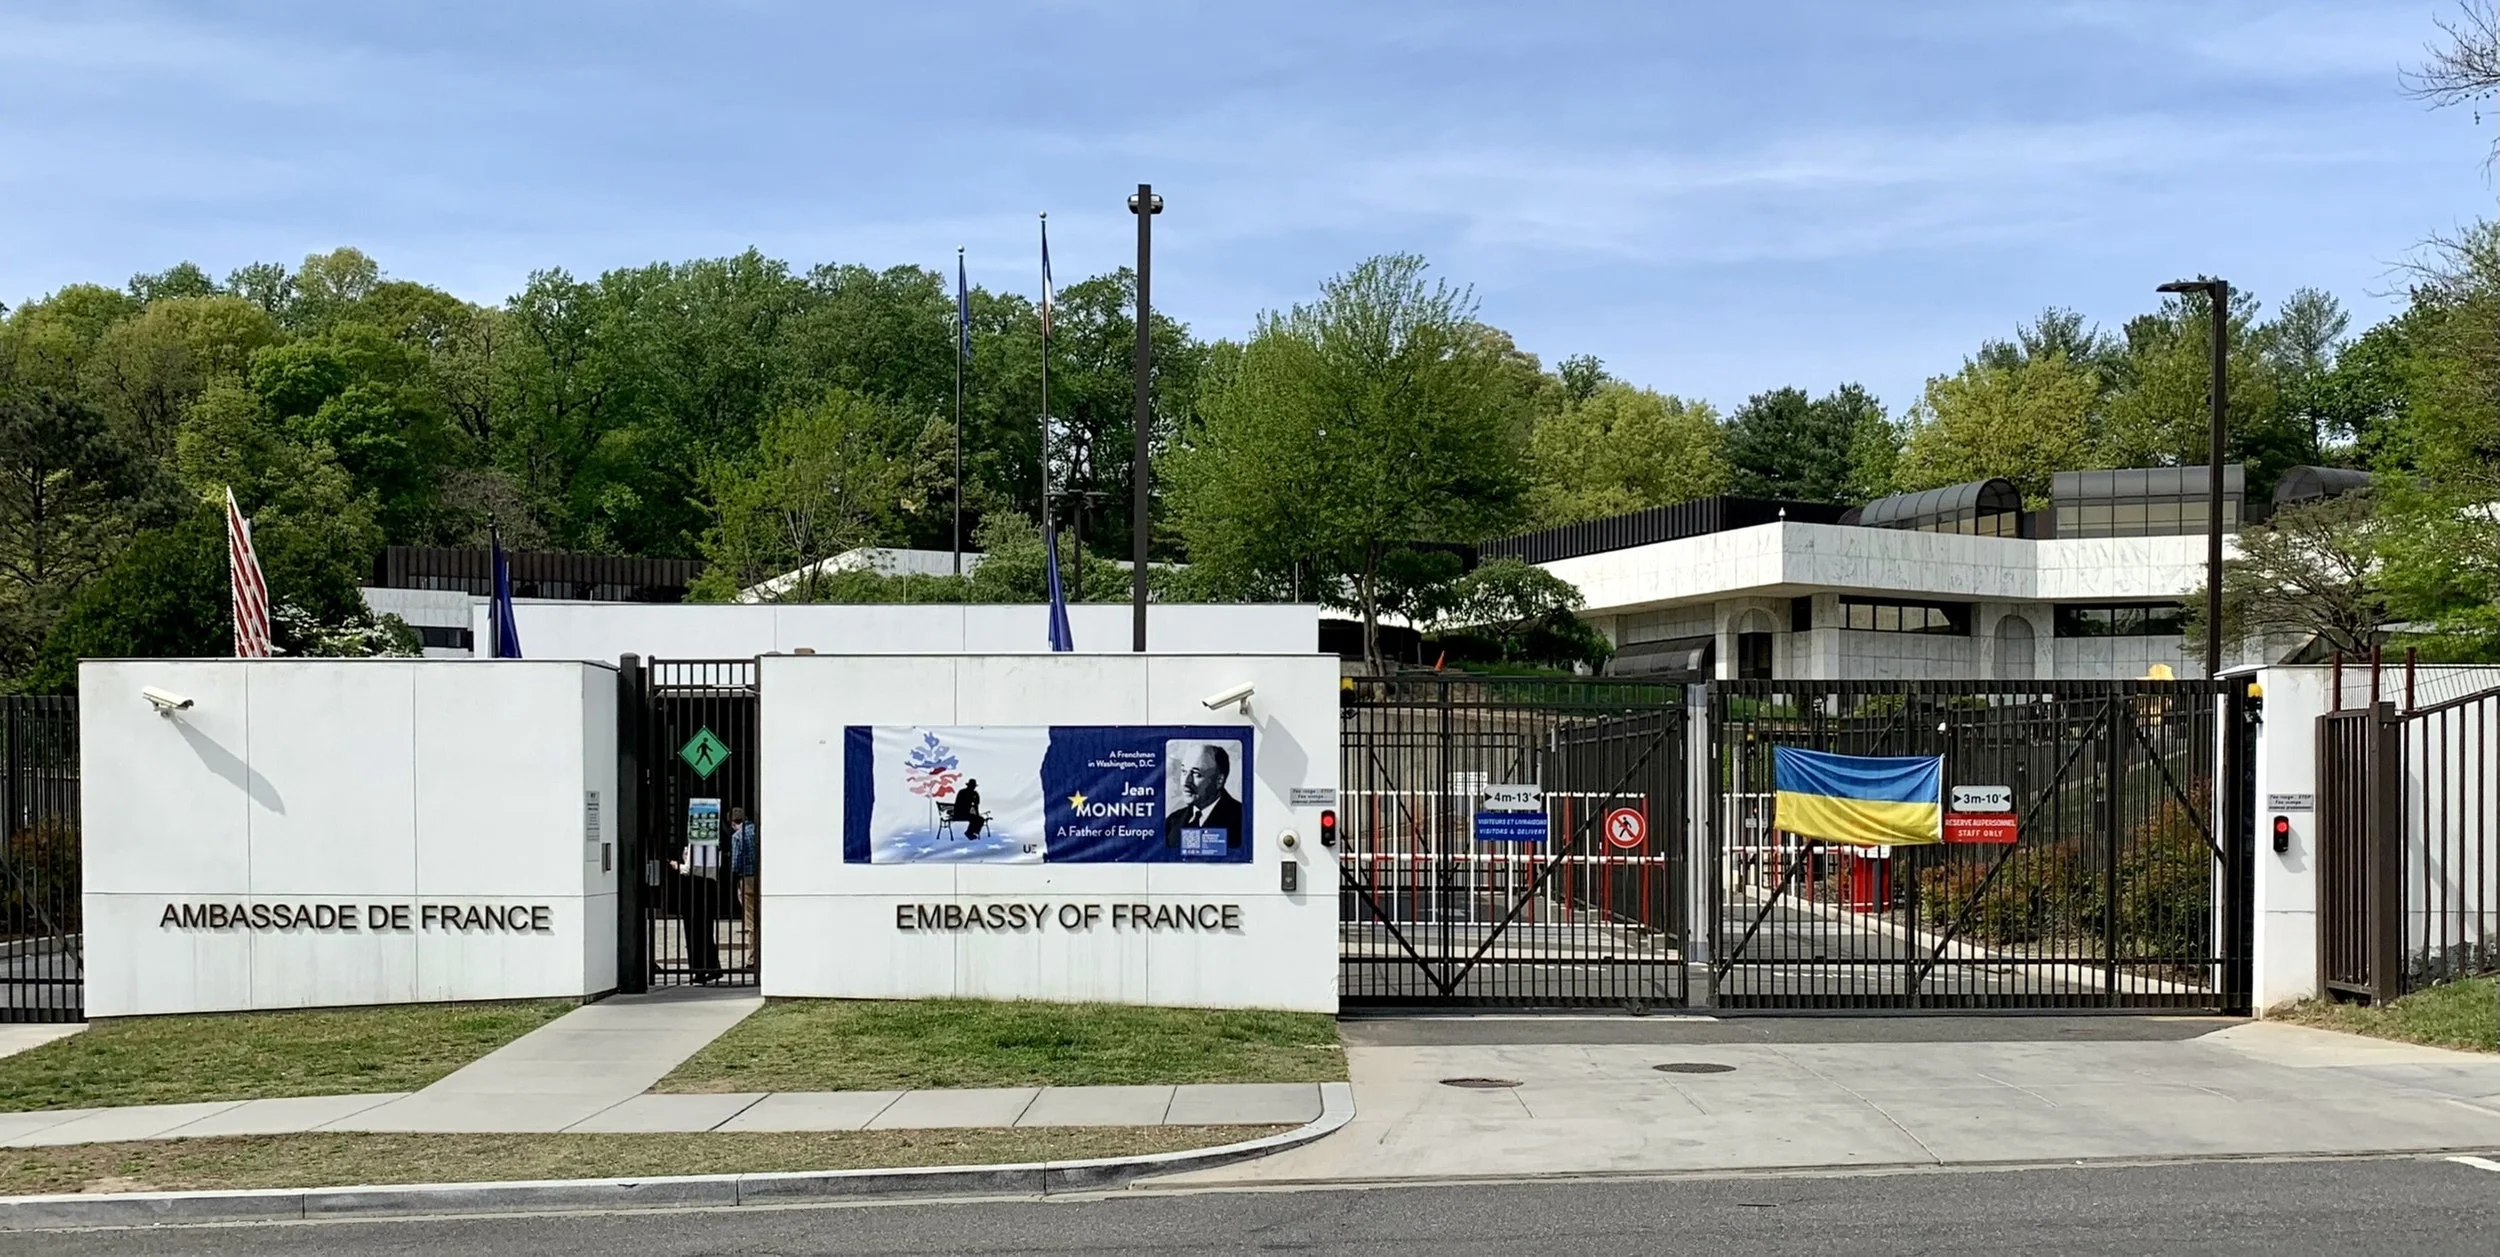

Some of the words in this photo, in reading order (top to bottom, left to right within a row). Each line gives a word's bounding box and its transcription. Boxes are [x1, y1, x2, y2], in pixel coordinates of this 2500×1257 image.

[1109, 750, 1117, 758] A
[1117, 750, 1155, 758] Frenchman
[1096, 760, 1138, 770] Washington,
[1121, 782, 1154, 796] Jean
[1075, 803, 1155, 817] MONNET
[1057, 827, 1066, 836] A
[1069, 826, 1101, 836] Father
[1105, 826, 1115, 836] of
[1118, 826, 1155, 840] Europe
[1958, 829, 1981, 837] STAFF
[1983, 829, 2004, 837] ONLY
[160, 903, 357, 929] AMBASSADE
[368, 904, 410, 929] DE
[421, 905, 550, 930] FRANCE
[896, 904, 1050, 929] EMBASSY
[1059, 904, 1101, 929] OF
[1112, 904, 1240, 929] FRANCE
